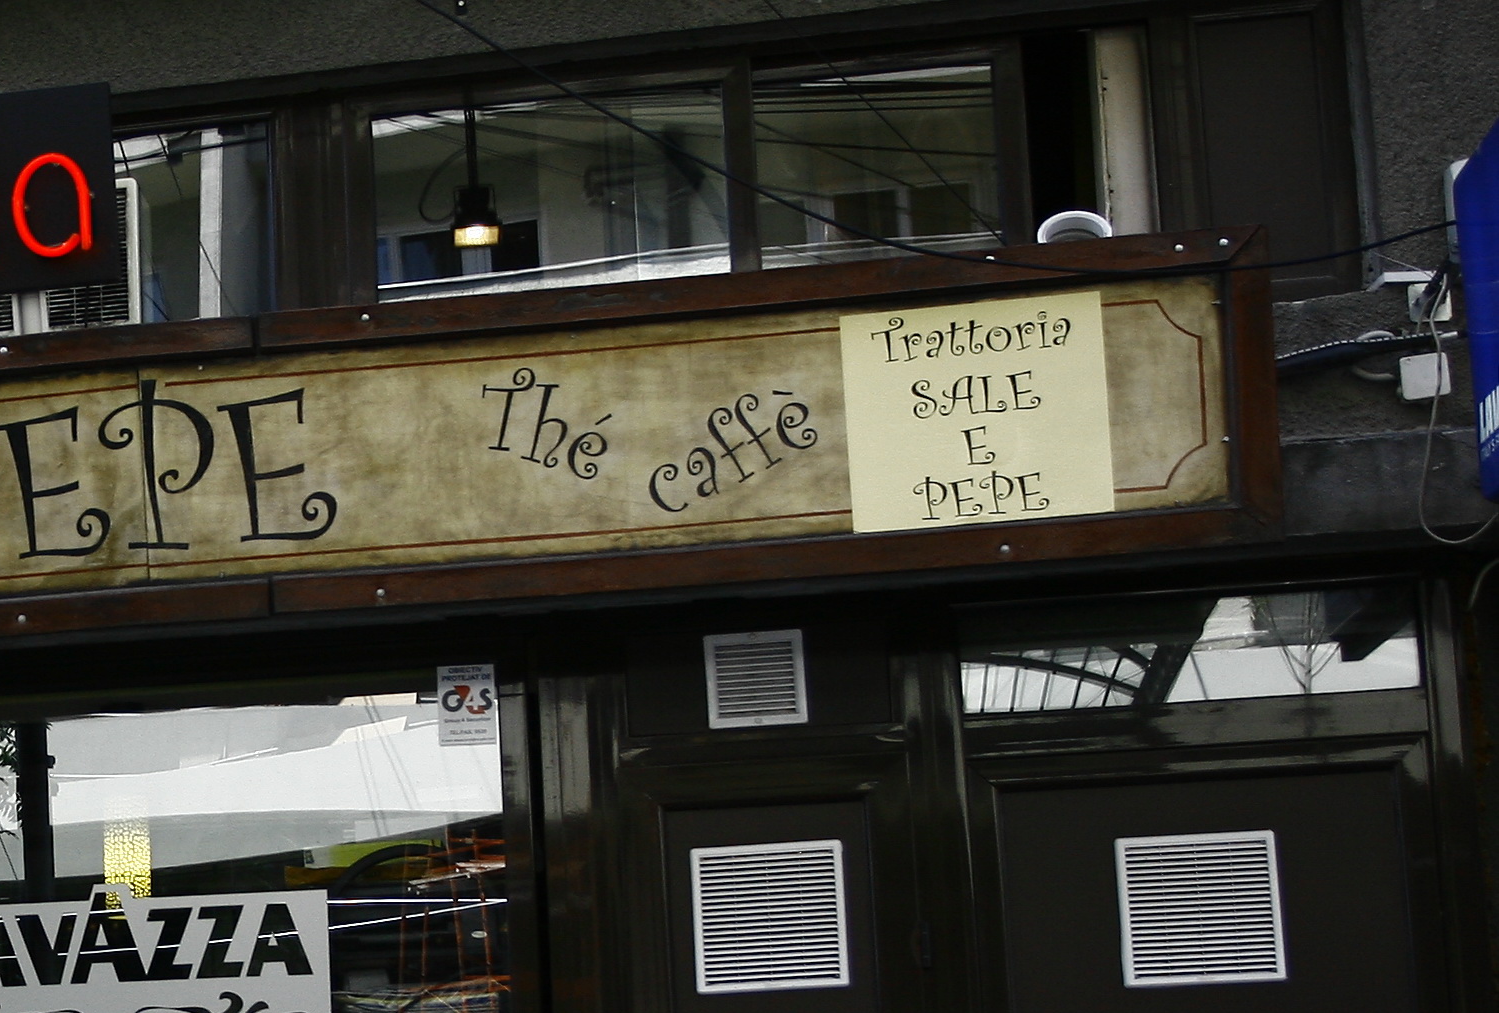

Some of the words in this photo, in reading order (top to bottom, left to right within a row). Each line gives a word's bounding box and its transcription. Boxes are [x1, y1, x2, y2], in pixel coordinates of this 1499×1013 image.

[871, 311, 1071, 363] Trattoria
[910, 370, 1041, 419] SALE
[482, 367, 613, 480] Thé
[648, 389, 818, 513] caffè
[961, 426, 995, 466] E
[913, 470, 1050, 520] PEPE
[441, 684, 492, 714] G4S
